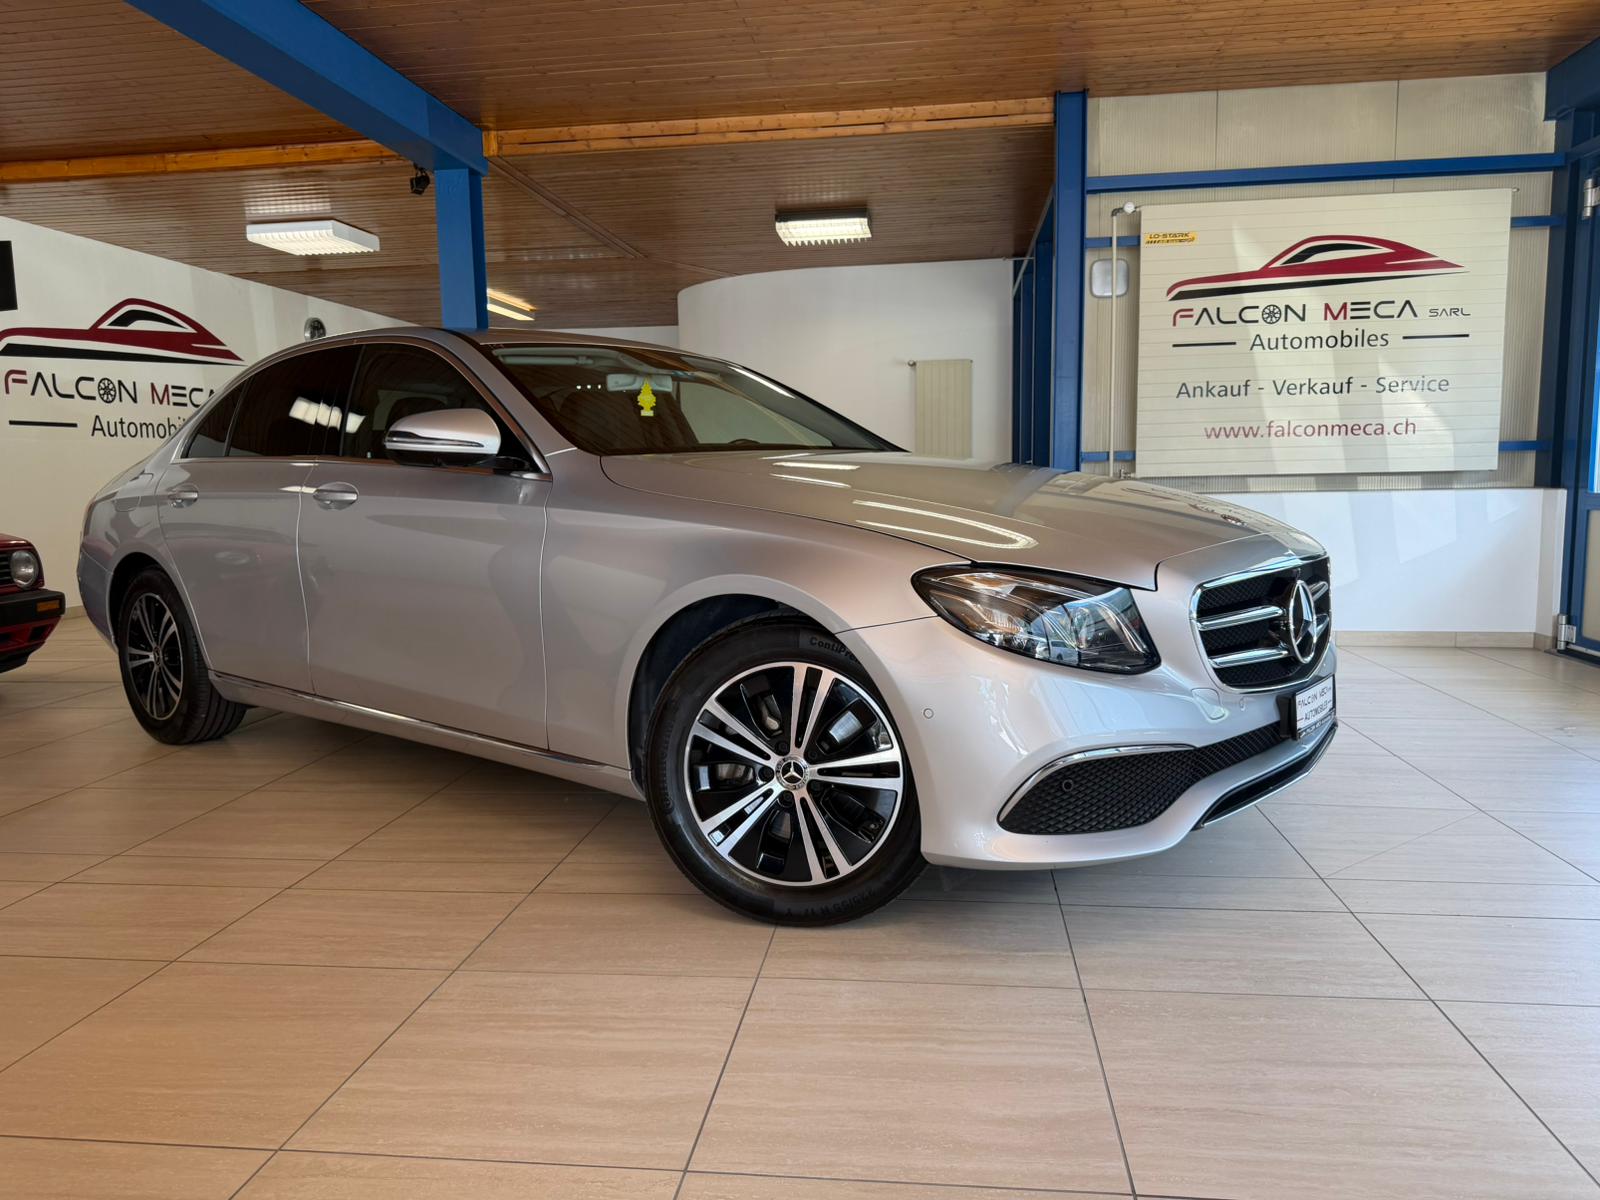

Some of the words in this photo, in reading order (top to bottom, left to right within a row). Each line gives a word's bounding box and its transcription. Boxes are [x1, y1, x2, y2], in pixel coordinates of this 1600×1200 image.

[1172, 303, 1306, 327] FALCON
[1323, 300, 1418, 321] MECA
[1428, 306, 1471, 318] SARL
[1249, 328, 1390, 351] Automobiles
[4, 369, 138, 404] FALCON
[1176, 380, 1251, 399] Ankauf
[1272, 377, 1354, 396] Verkauf
[1375, 375, 1450, 395] Service
[91, 415, 186, 439] Automob
[1204, 418, 1417, 439] www.falconmeca.ch
